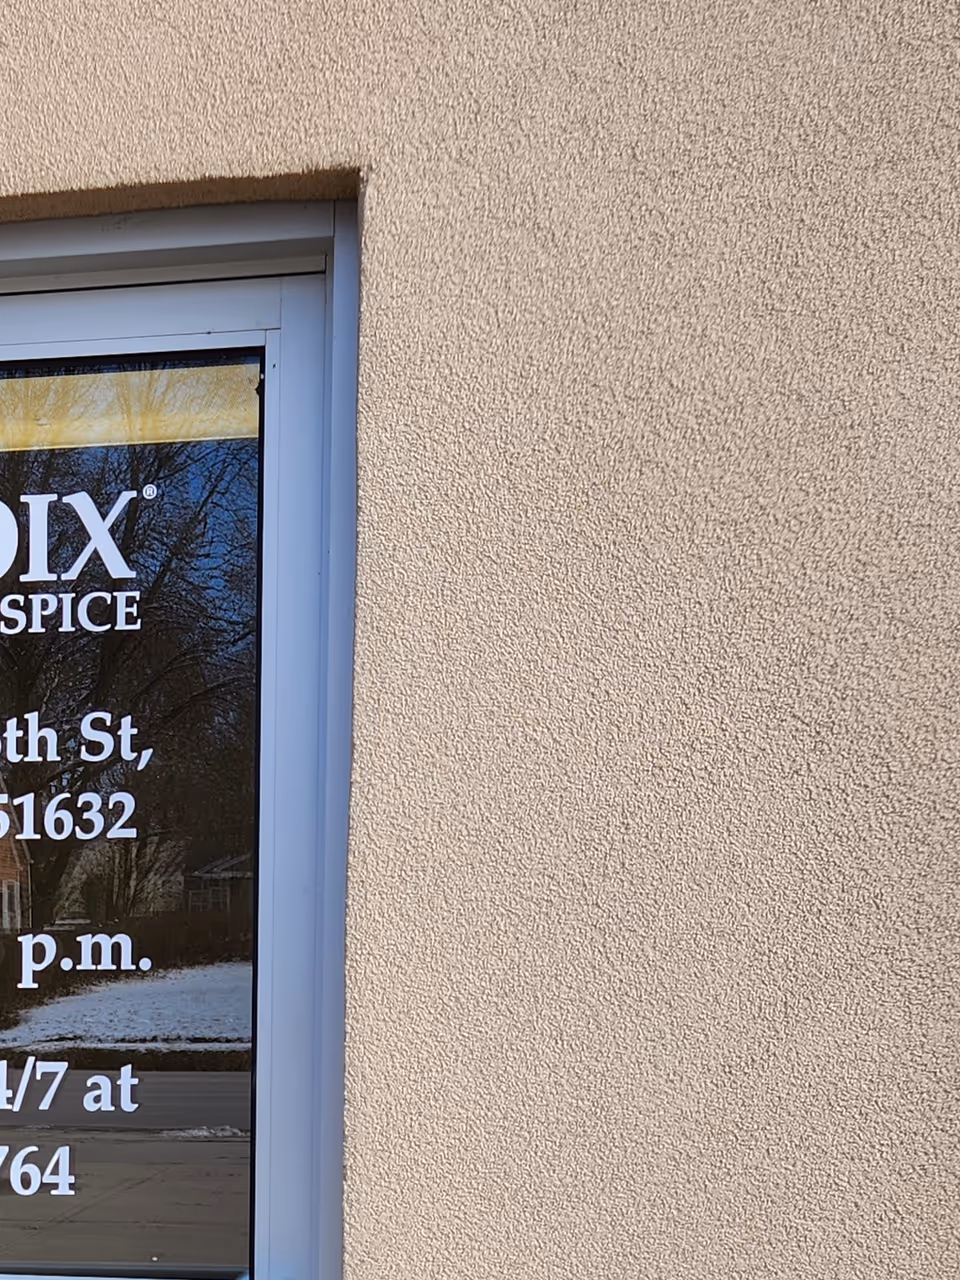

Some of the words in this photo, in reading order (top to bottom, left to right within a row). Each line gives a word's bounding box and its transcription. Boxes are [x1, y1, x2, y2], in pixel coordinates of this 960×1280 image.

[80, 711, 154, 771] St,
[16, 933, 152, 989] p.m.
[83, 1063, 139, 1112] at
